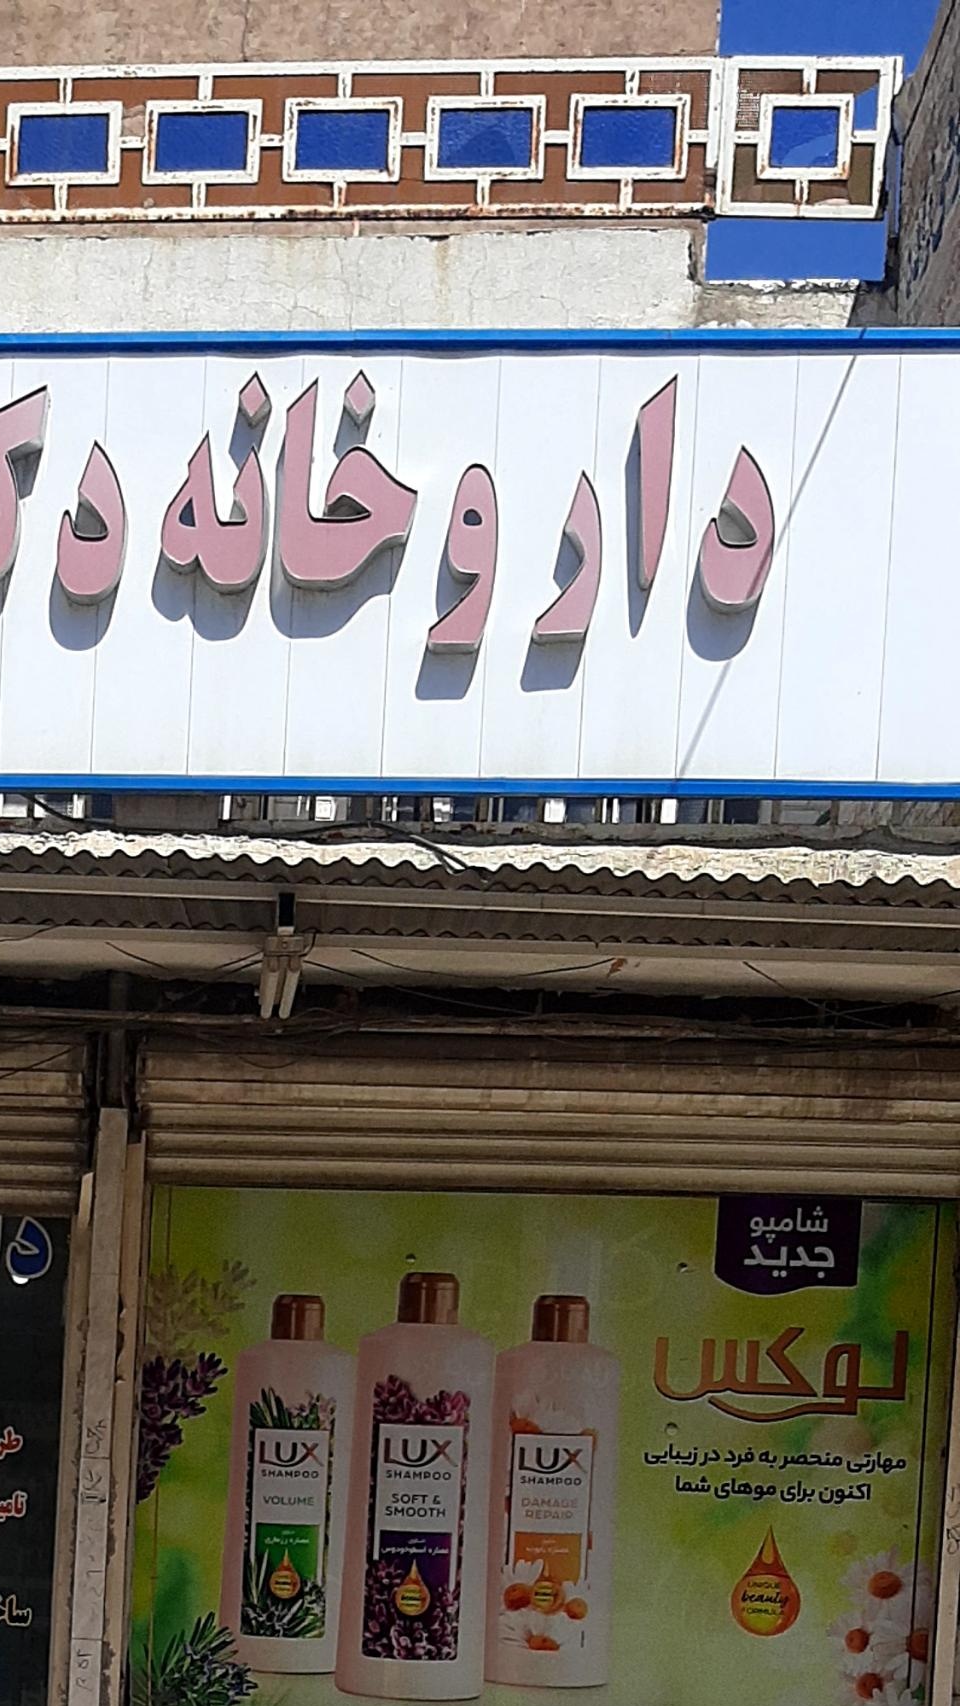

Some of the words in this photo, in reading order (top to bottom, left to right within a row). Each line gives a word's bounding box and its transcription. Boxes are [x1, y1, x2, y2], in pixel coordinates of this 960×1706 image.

[160, 369, 777, 653] داروخانه
[748, 1204, 830, 1244] شامپو
[742, 1243, 836, 1279] جدید
[652, 1326, 910, 1424] لوکس
[258, 1440, 325, 1468] LUX
[383, 1437, 458, 1468] LUX
[518, 1446, 588, 1475] LUX
[643, 1443, 699, 1466] زیبایی
[700, 1448, 721, 1466] در
[724, 1446, 754, 1468] فرد
[757, 1449, 780, 1469] به
[779, 1449, 843, 1470] منحصر
[845, 1451, 908, 1474] مهارتی
[260, 1468, 320, 1480] SHAMPOO
[385, 1469, 452, 1482] SHAMPOO
[519, 1475, 582, 1487] SHAMPOO
[675, 1475, 712, 1494] شما
[713, 1476, 778, 1500] موهای
[780, 1480, 816, 1503] برای
[818, 1482, 872, 1505] اکنون
[263, 1495, 315, 1507] VOLUME
[391, 1493, 429, 1505] SOFT
[520, 1497, 578, 1509] DAMAGE
[384, 1505, 446, 1518] SMOOTH
[524, 1508, 574, 1520] REPAIR
[740, 1589, 789, 1609] beauty
